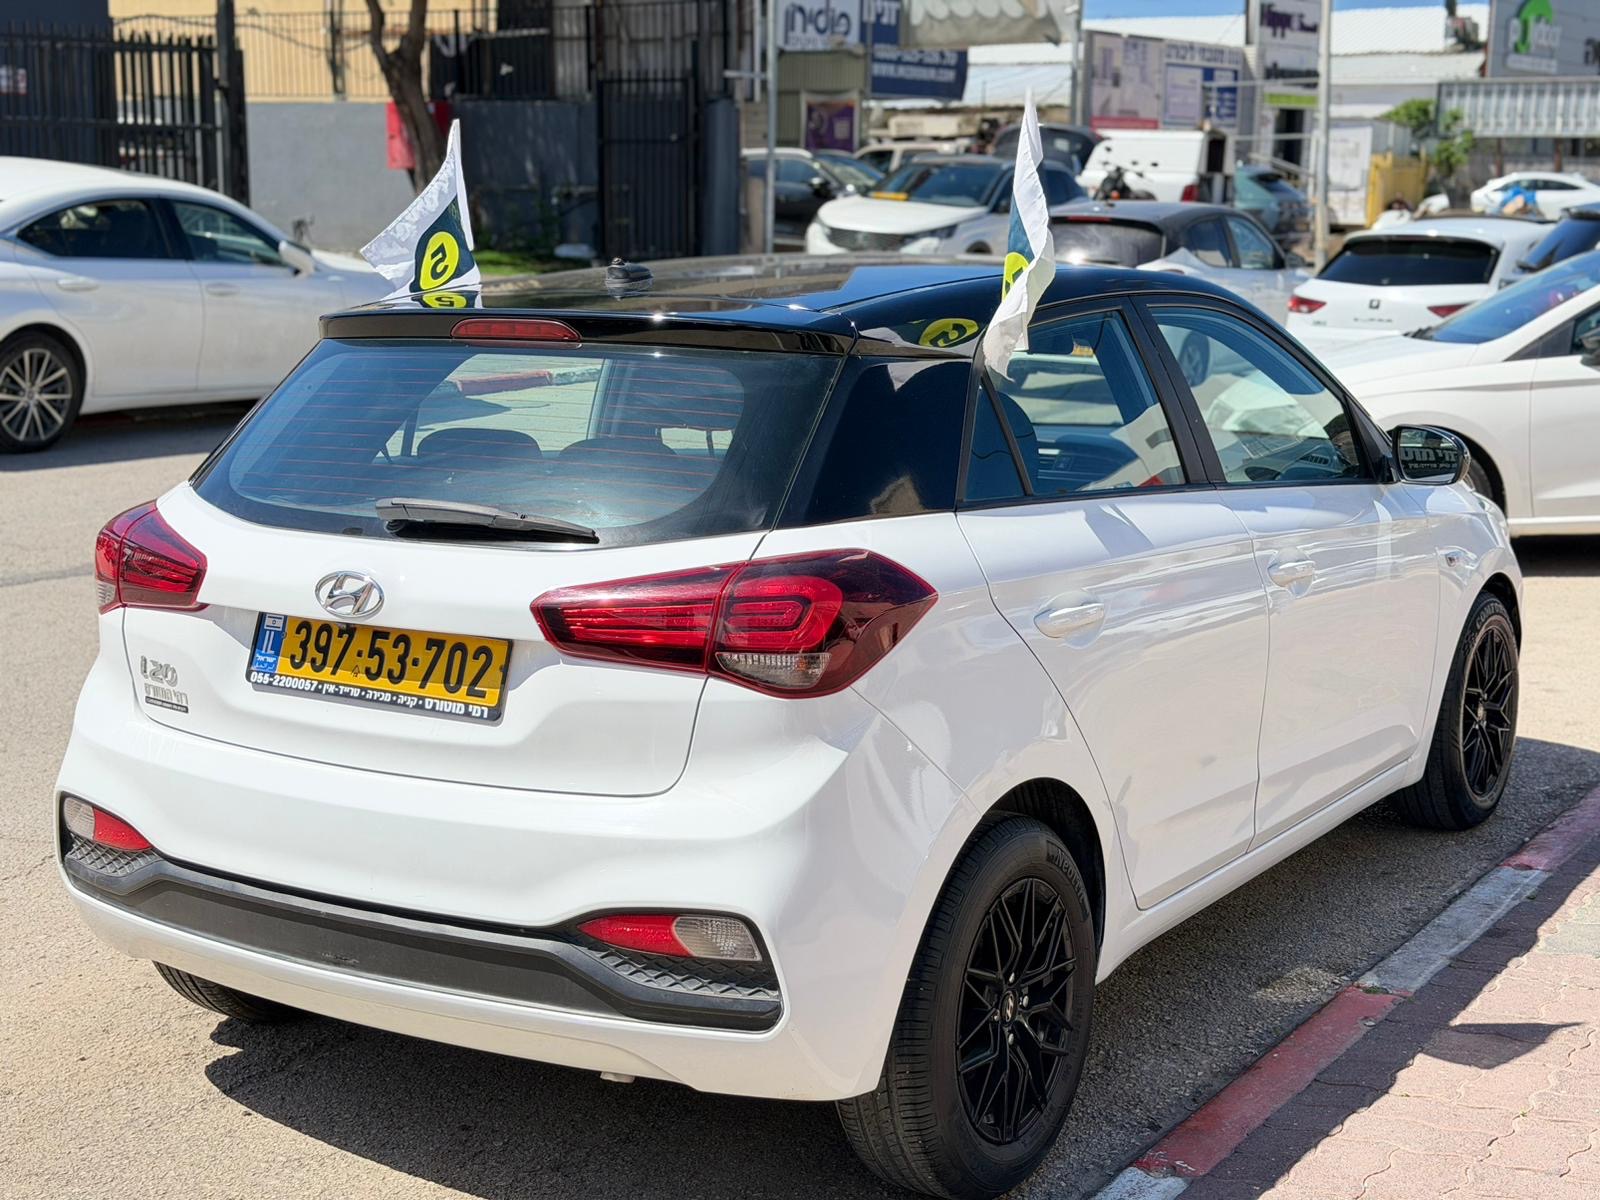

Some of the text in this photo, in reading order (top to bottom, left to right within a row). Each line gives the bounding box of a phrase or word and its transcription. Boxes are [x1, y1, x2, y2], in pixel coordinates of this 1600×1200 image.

[262, 631, 275, 654] IL
[250, 671, 489, 719] רמי מוטורס קניה מכירה טרייד-אין 055-2200057
